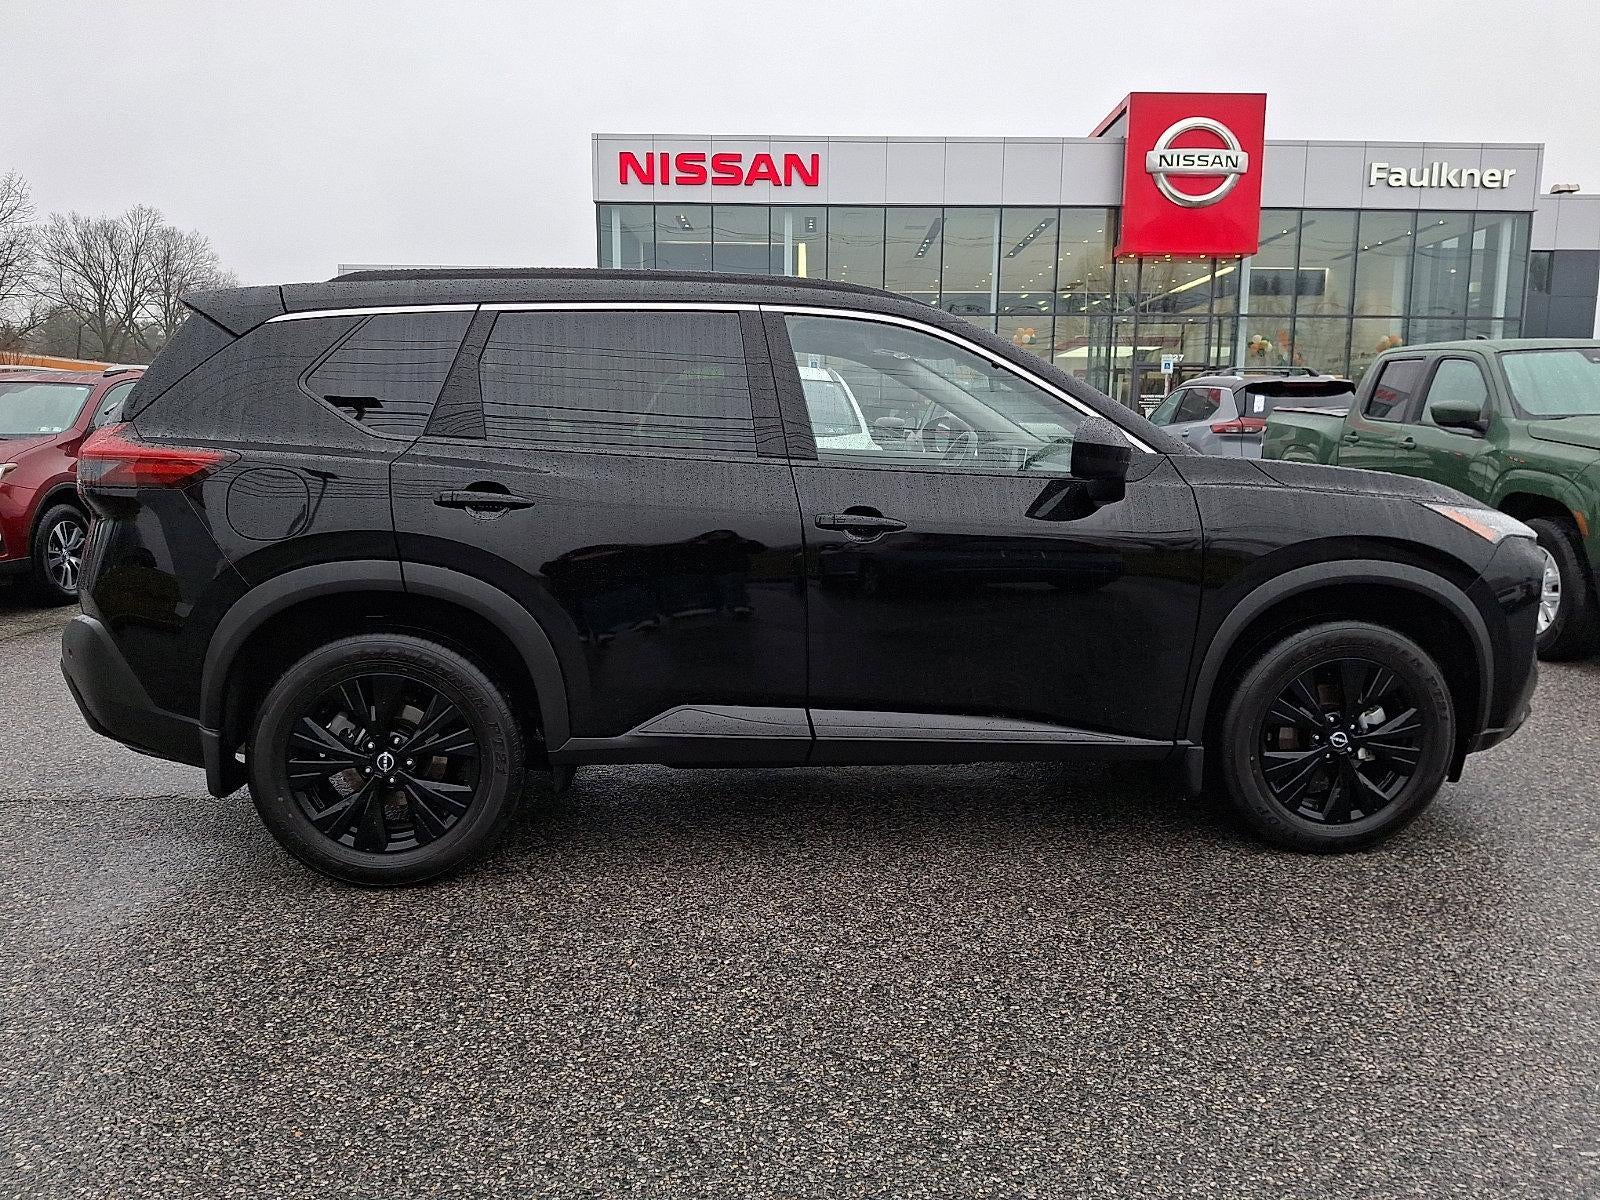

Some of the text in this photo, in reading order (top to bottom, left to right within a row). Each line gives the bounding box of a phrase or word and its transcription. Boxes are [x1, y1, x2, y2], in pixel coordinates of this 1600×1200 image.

[619, 152, 820, 187] NISSAN
[1159, 153, 1239, 169] NISSAN
[1369, 162, 1516, 188] Faulkner
